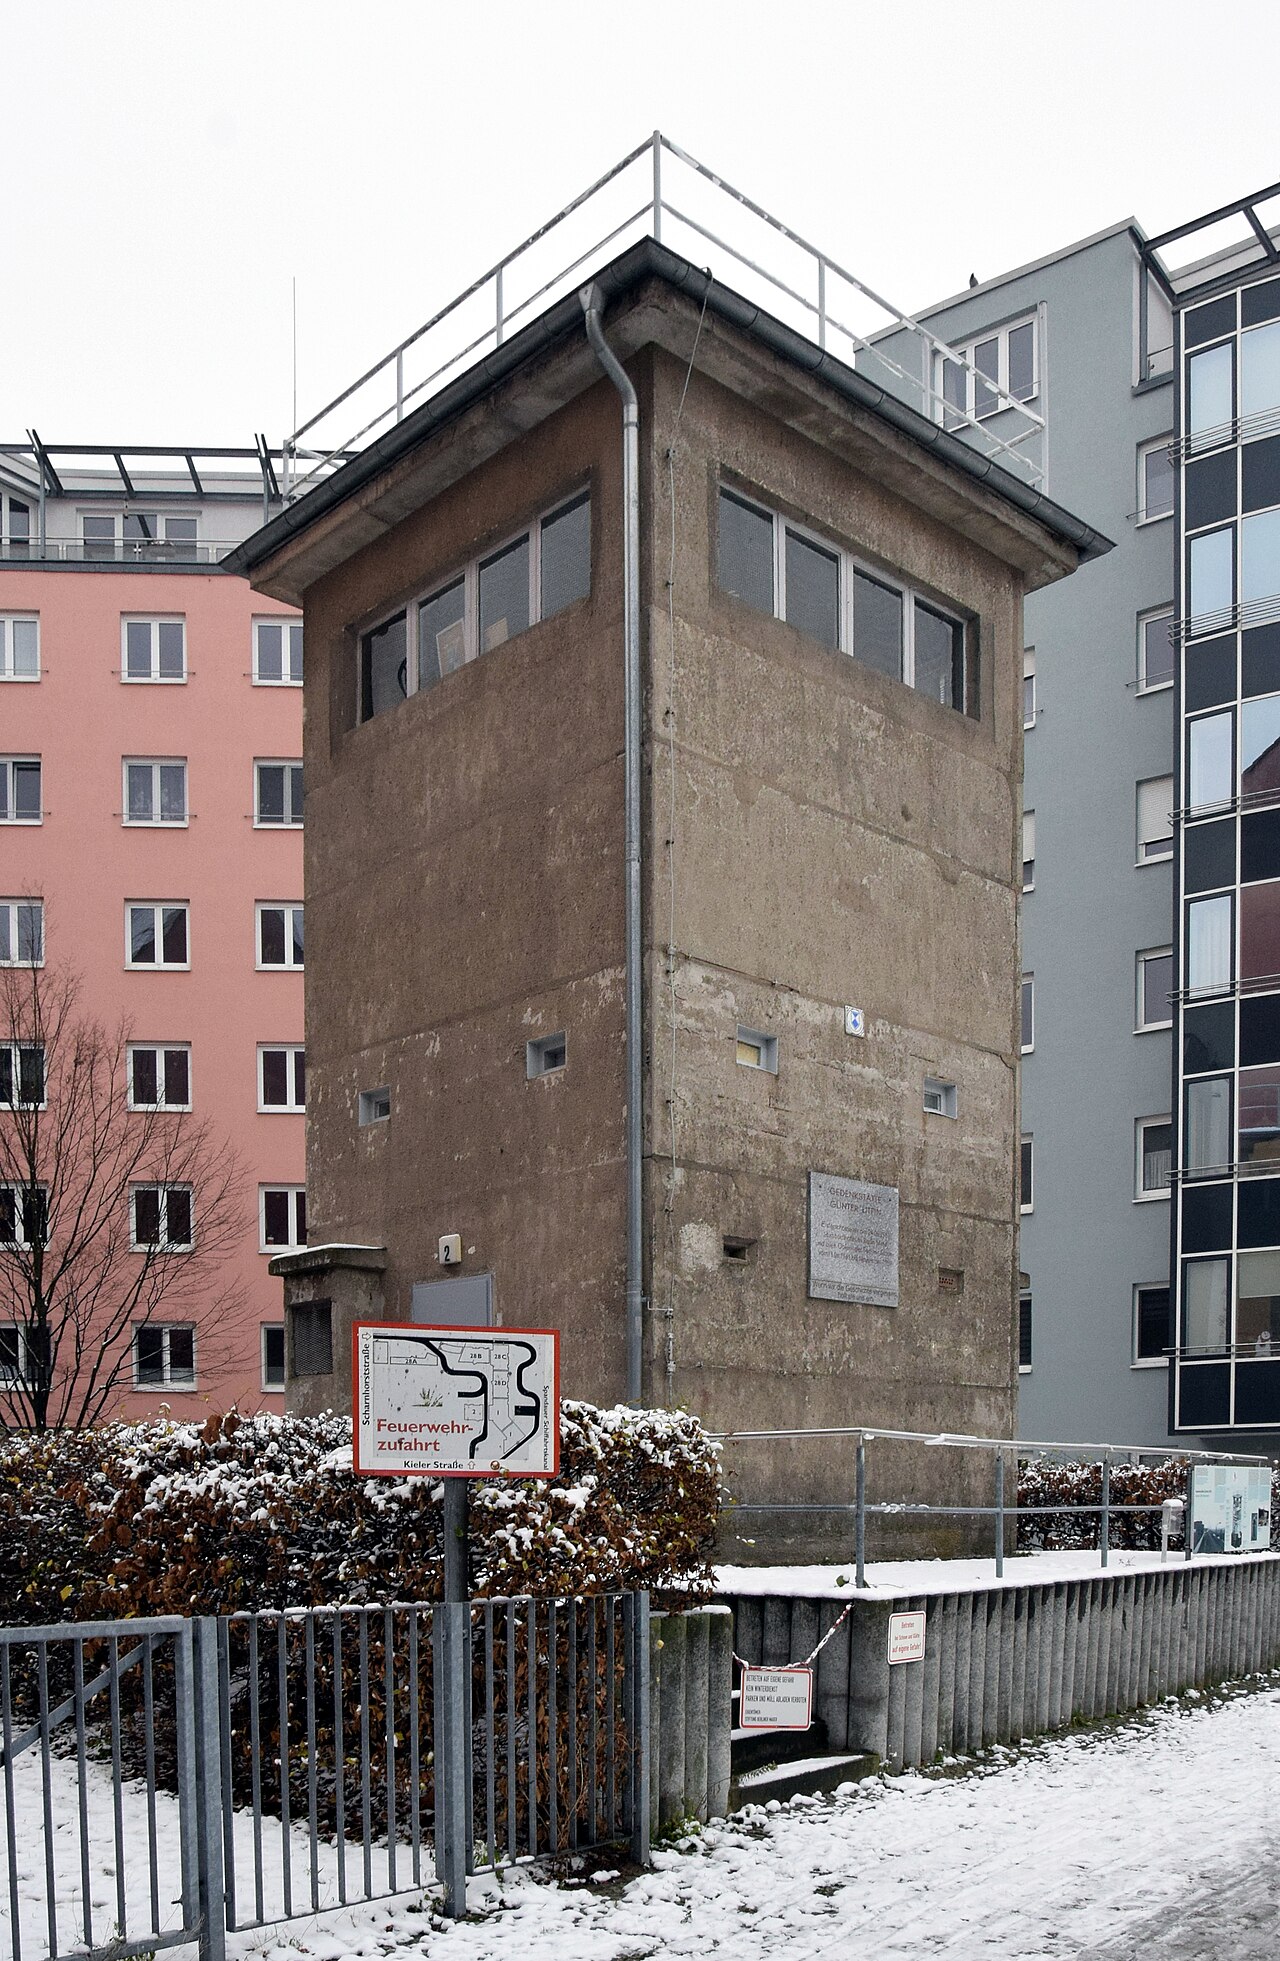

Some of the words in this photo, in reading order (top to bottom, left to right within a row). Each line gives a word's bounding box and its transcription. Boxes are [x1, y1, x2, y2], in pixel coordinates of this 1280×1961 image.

[444, 1245, 450, 1262] 2
[362, 1343, 370, 1426] Scharnhorststraße
[542, 1385, 550, 1419] Spandauer
[377, 1418, 473, 1434] Feuerwehr-
[377, 1437, 440, 1451] zufahrt
[404, 1460, 431, 1469] Kieler
[433, 1460, 464, 1469] Straße
